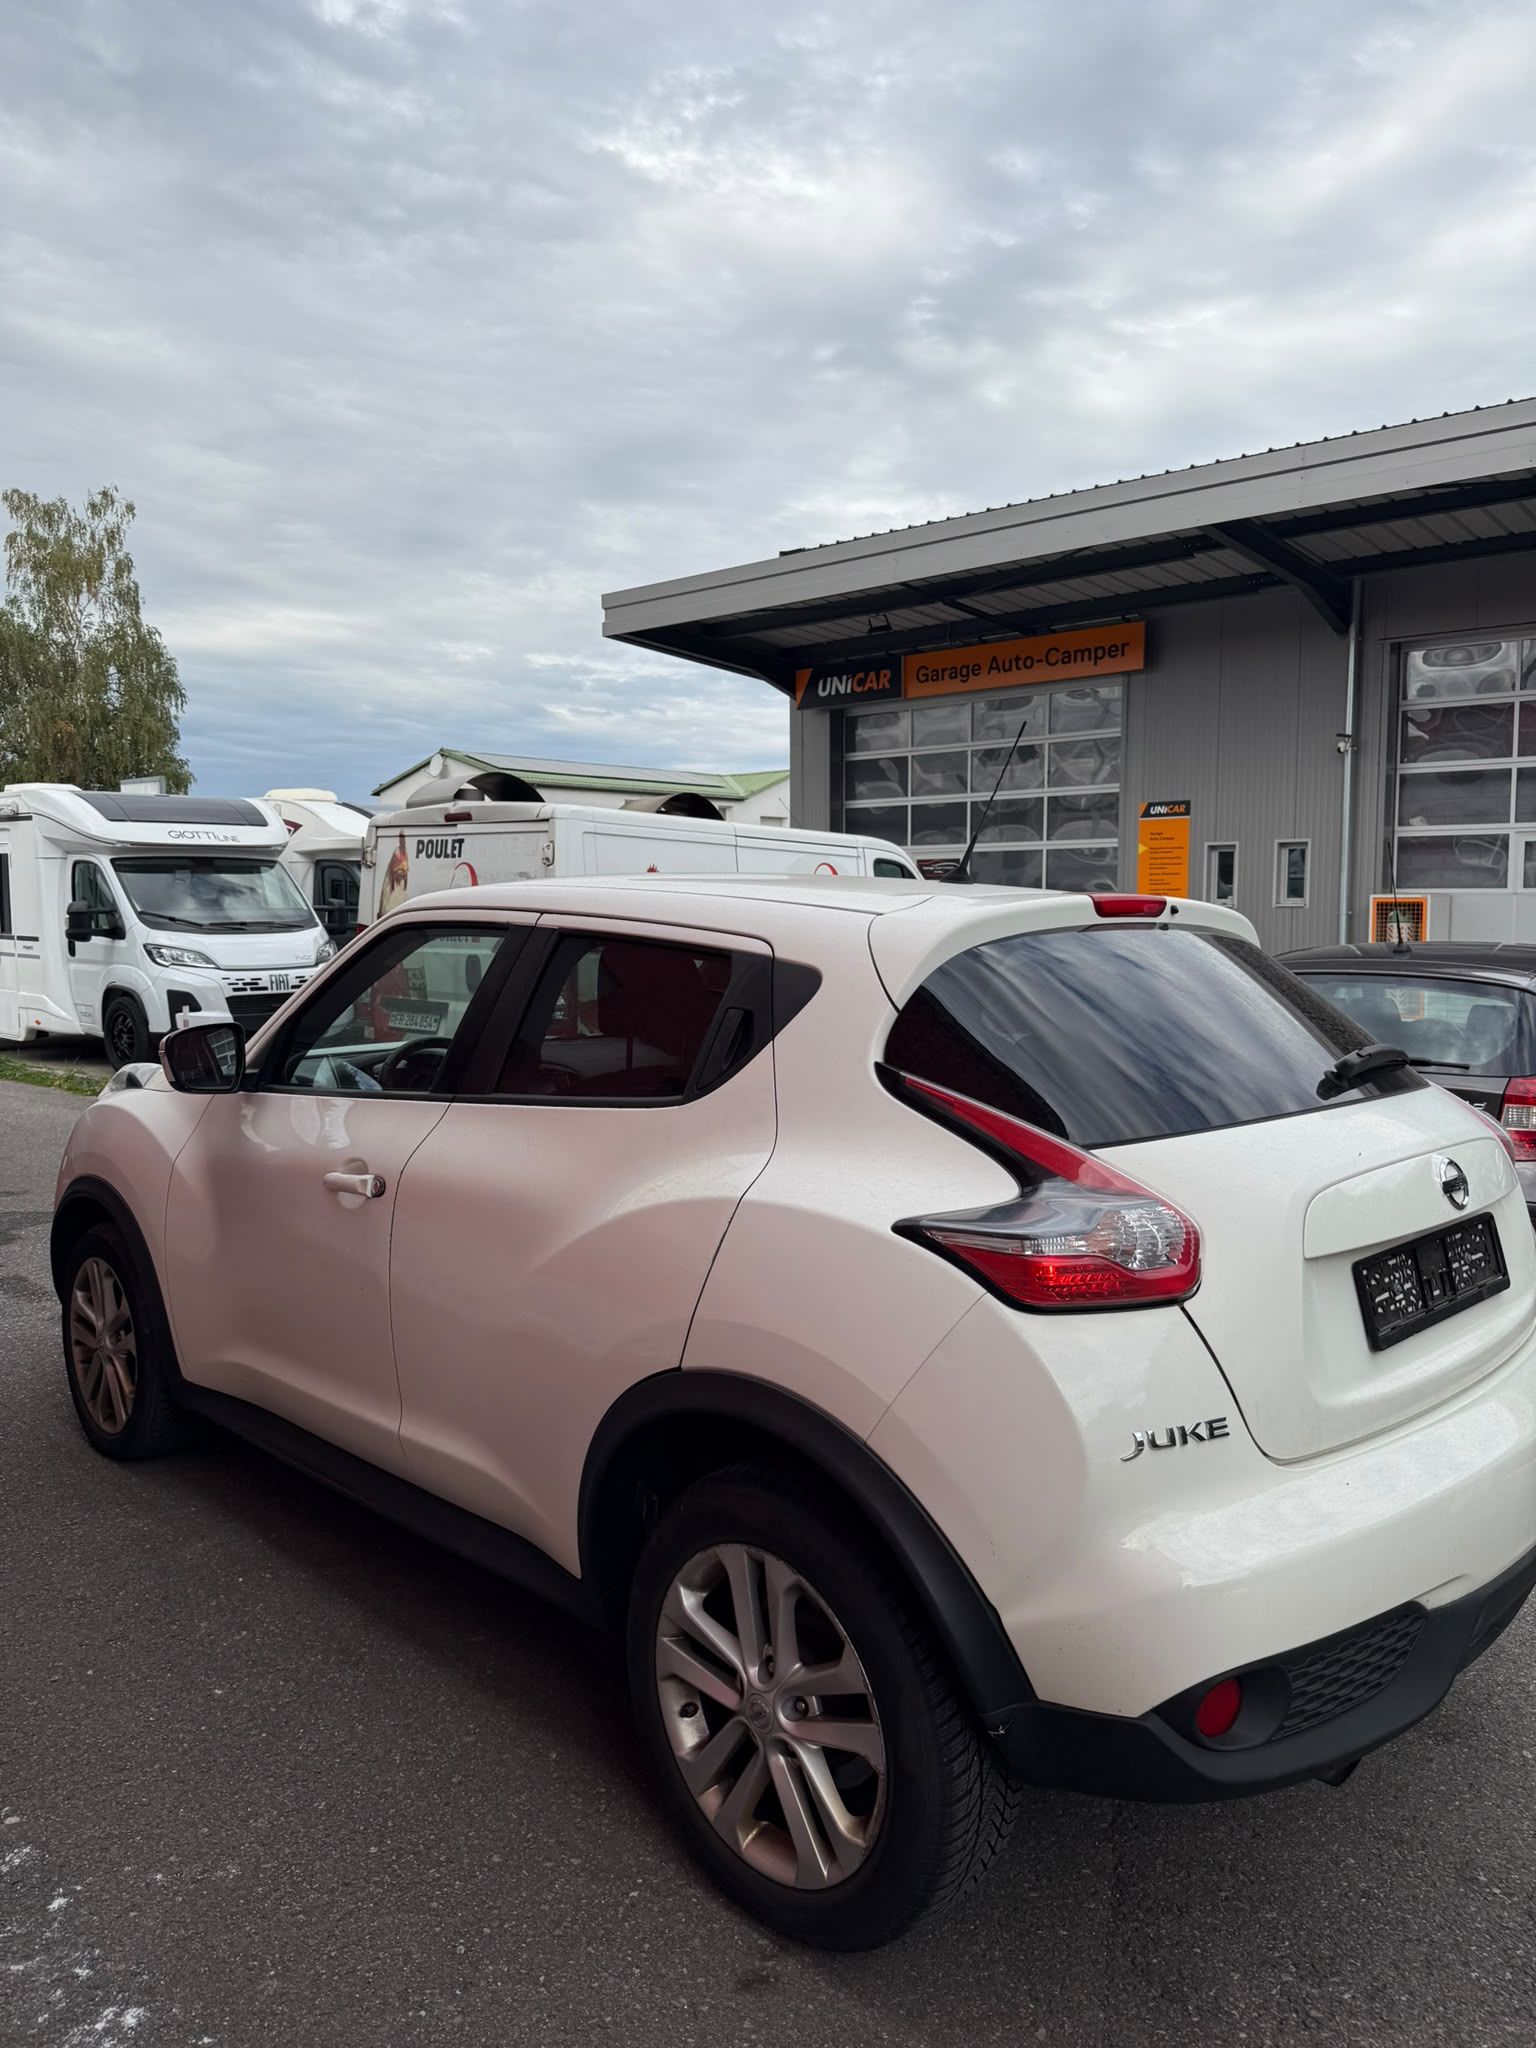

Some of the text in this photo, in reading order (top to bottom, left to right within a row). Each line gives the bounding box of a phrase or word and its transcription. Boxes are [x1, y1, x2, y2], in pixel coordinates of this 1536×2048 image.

[916, 642, 1130, 683] Garage Auto-Camper
[416, 838, 465, 859] POULET
[269, 974, 290, 991] FIAT
[1120, 1416, 1230, 1462] JUKE
